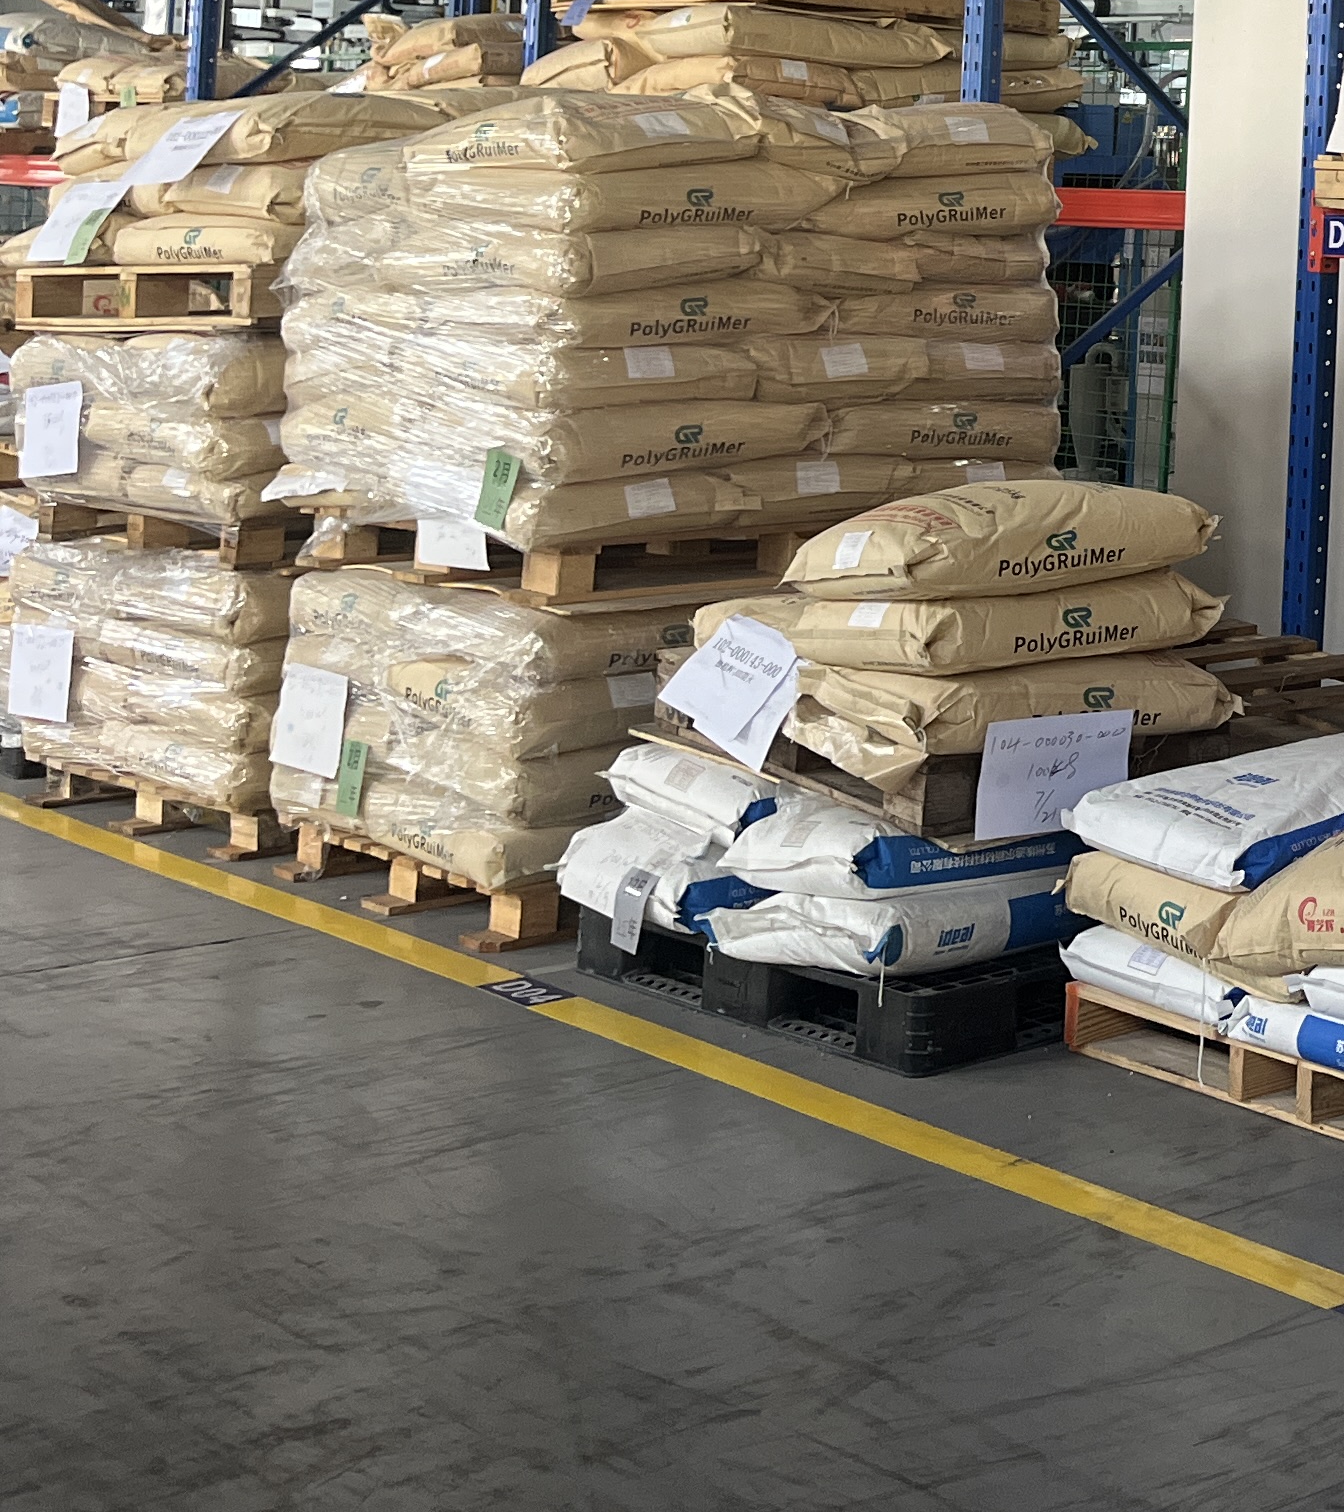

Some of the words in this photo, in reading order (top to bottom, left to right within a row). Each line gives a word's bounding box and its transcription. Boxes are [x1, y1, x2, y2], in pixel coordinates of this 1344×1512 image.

[638, 202, 755, 227] PolyGRuiMer
[896, 201, 1007, 230] PolyGRuiMer
[629, 313, 751, 340] PolyGRuiMer
[909, 426, 1013, 450] PolyGRuiMer
[620, 438, 746, 470] PolyGRuiMer
[998, 545, 1126, 579] PolyGRuiMer
[1012, 622, 1139, 656] PolyGRuiMer
[937, 922, 976, 948] ideal
[1118, 905, 1204, 961] PolyGRuiM
